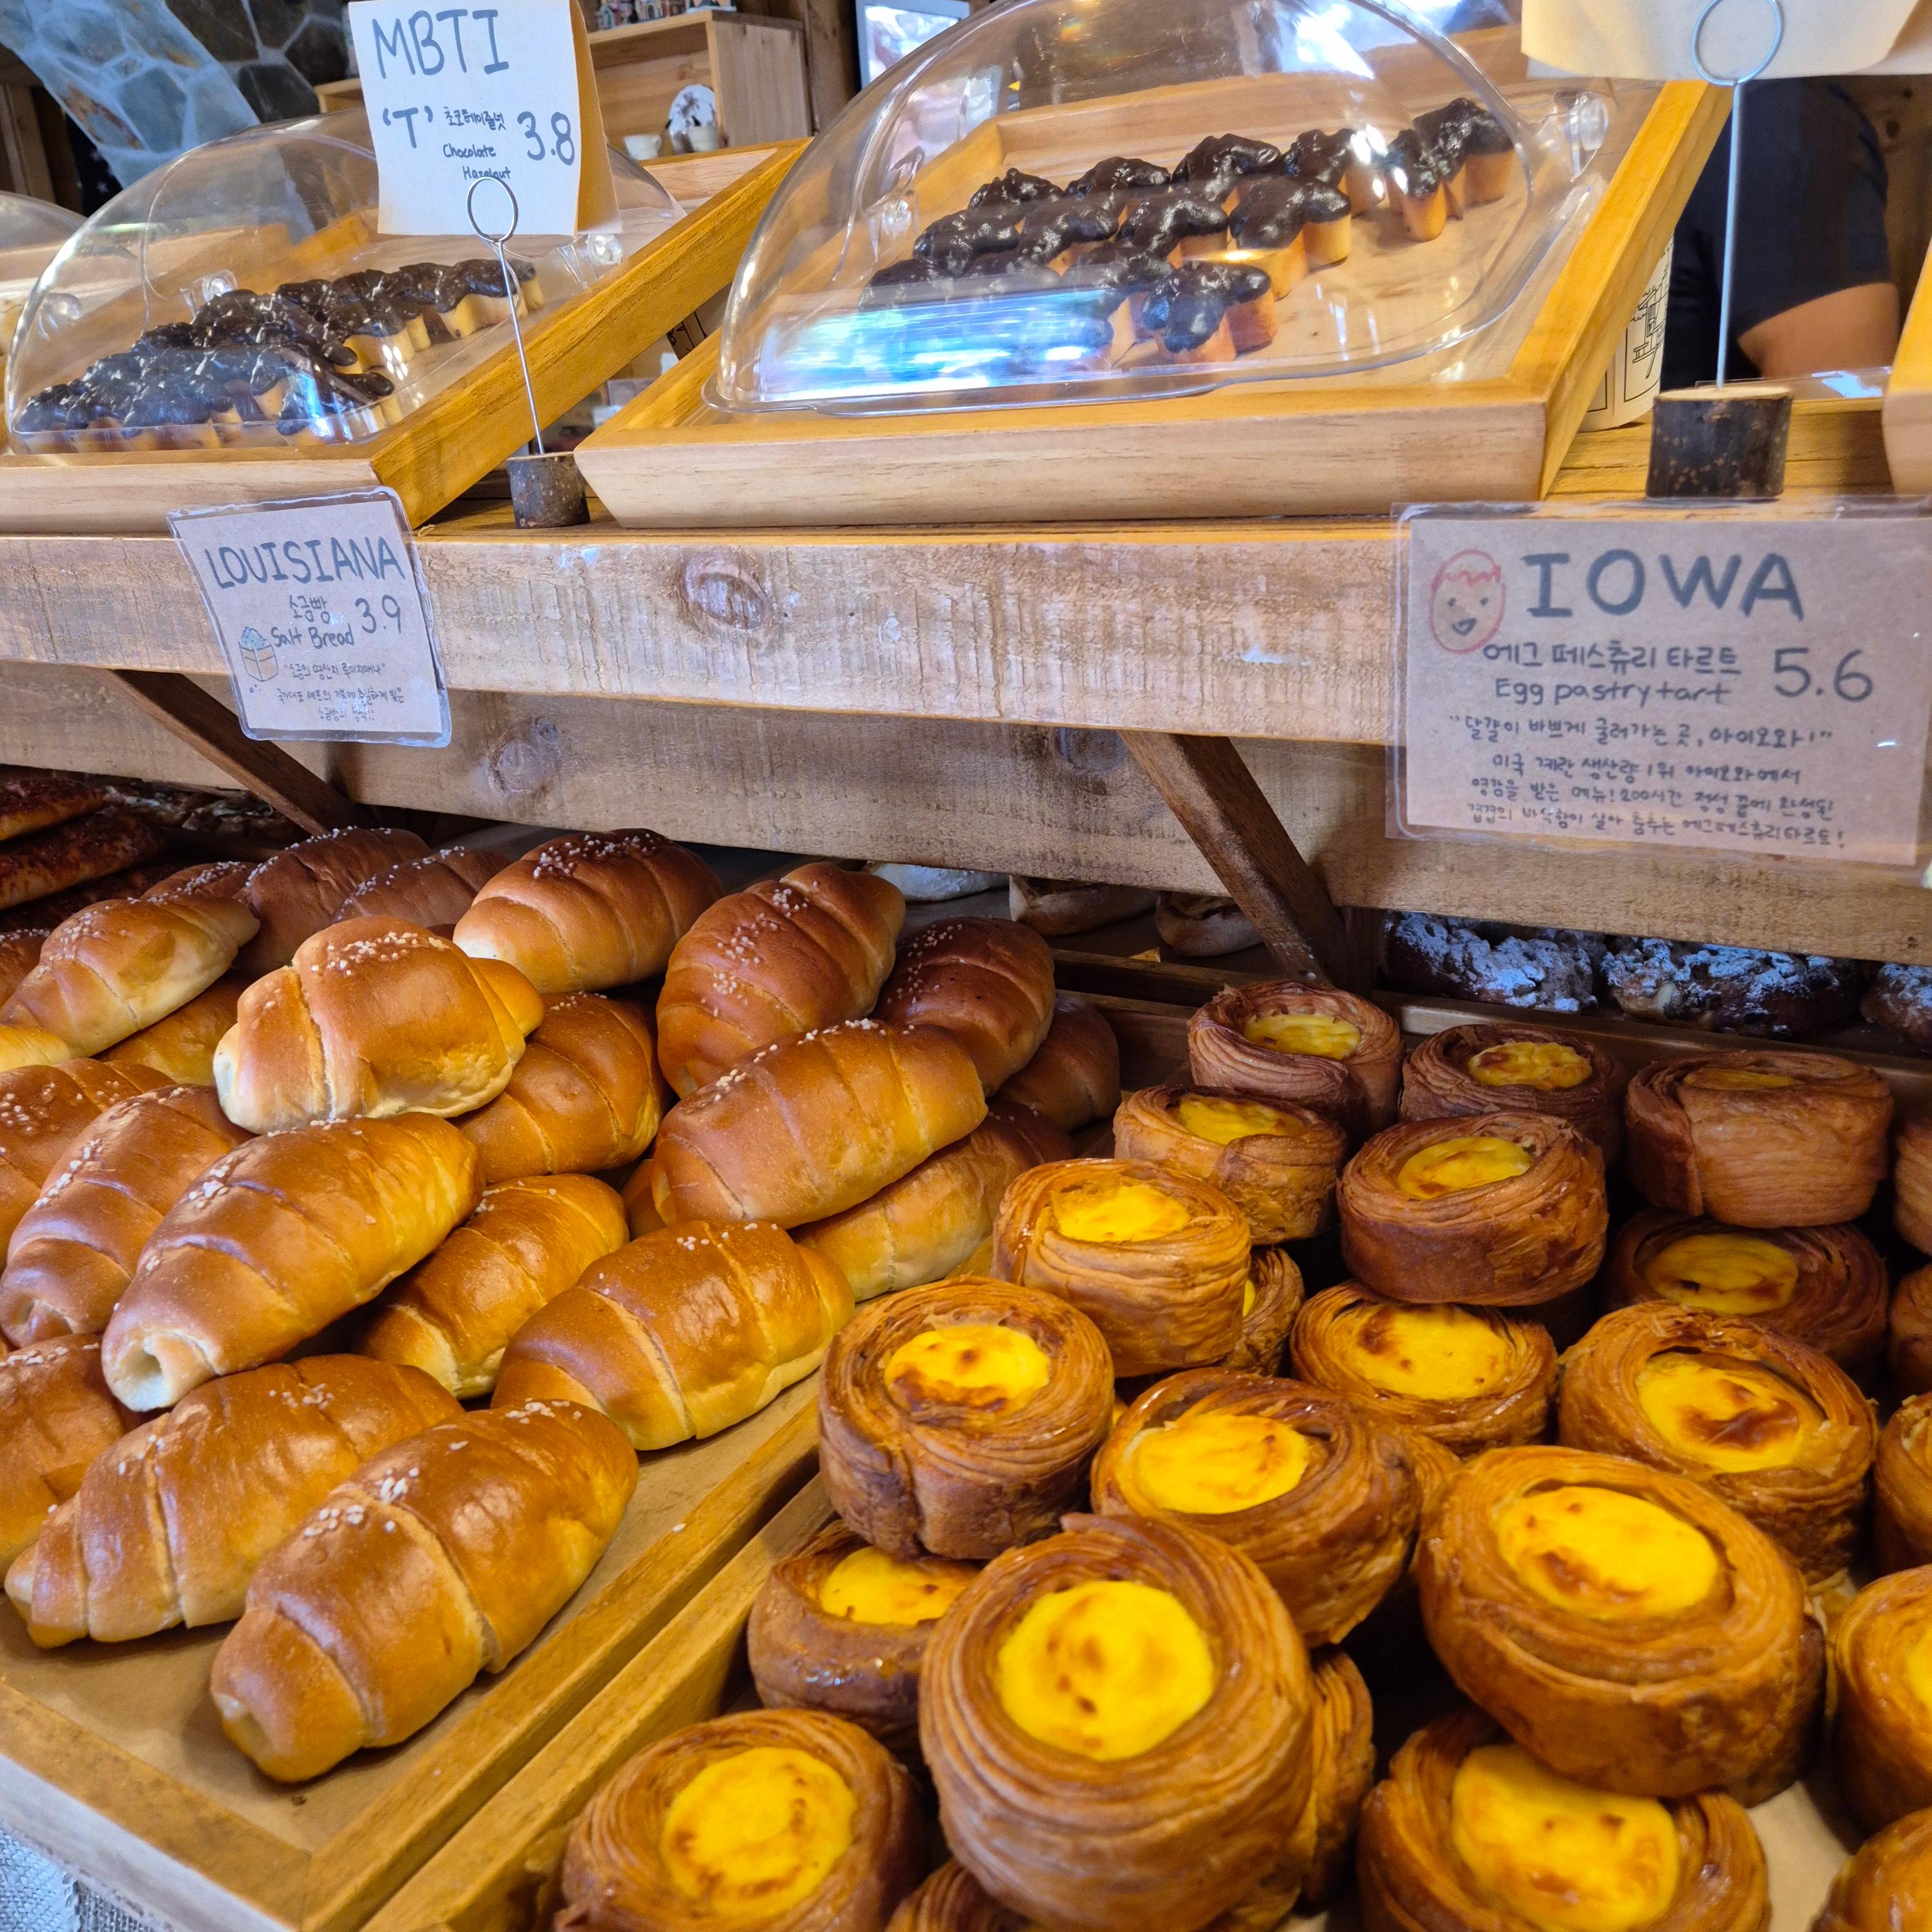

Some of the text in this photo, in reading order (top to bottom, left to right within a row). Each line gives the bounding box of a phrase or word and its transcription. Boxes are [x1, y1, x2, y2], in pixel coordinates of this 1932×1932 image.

[372, 9, 509, 79] MBTI
[442, 143, 497, 158] Chocolate
[517, 111, 575, 166] 3.8
[462, 165, 511, 180] Hazelnut
[204, 537, 406, 589] LOUISIANA
[1520, 549, 1804, 621] IOWA
[289, 595, 402, 634] 소금빵 3.9
[271, 623, 355, 649] Salt Bread
[1483, 640, 1873, 703] 에그 페스츄리 타르트 5.6
[277, 688, 304, 703] 국가대표
[1495, 678, 1732, 707] Egg pastry tart
[1528, 719, 1585, 737] 바쁘게
[1595, 717, 1668, 746] 굴러가는
[1493, 753, 1801, 785] 미국 계란 생산량 1위 아이오와에서
[1472, 778, 1519, 801] 영감을
[1530, 783, 1559, 801] 받은
[1619, 788, 1682, 807] 200시간
[1695, 791, 1728, 814] 정성
[1735, 794, 1771, 817] 끝에
[1780, 796, 1833, 821] 완성된
[1468, 803, 1512, 825] 겹겹의
[1523, 807, 1583, 829] 바삭함이
[1592, 812, 1624, 830] 살아
[1632, 812, 1675, 836] 춤추는
